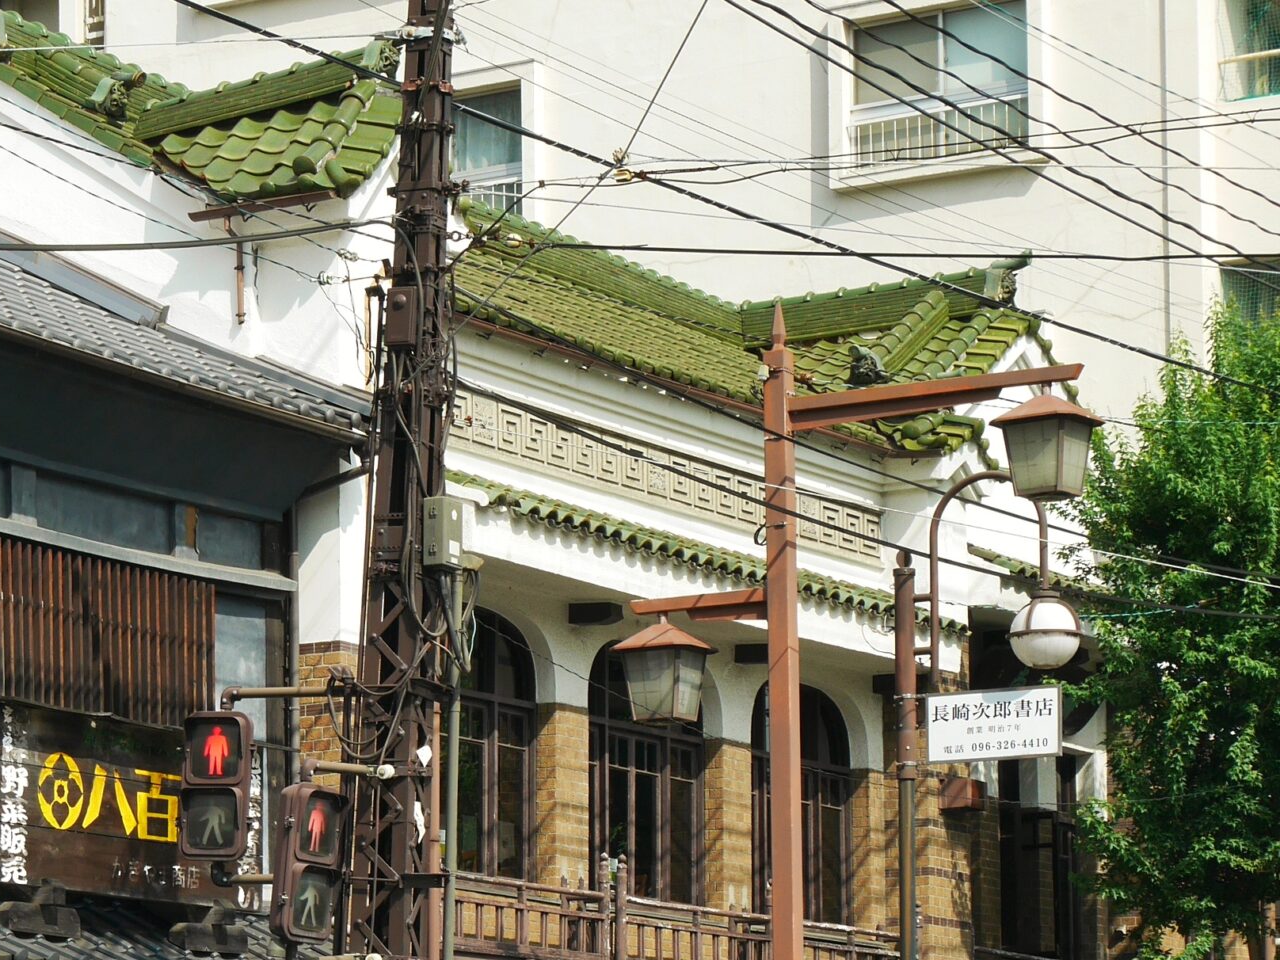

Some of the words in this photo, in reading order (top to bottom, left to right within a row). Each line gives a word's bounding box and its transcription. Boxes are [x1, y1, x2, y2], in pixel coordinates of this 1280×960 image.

[931, 697, 1054, 723] 長崎次郎書店
[943, 744, 965, 754] 電話
[971, 737, 1049, 752] 096-326-4410
